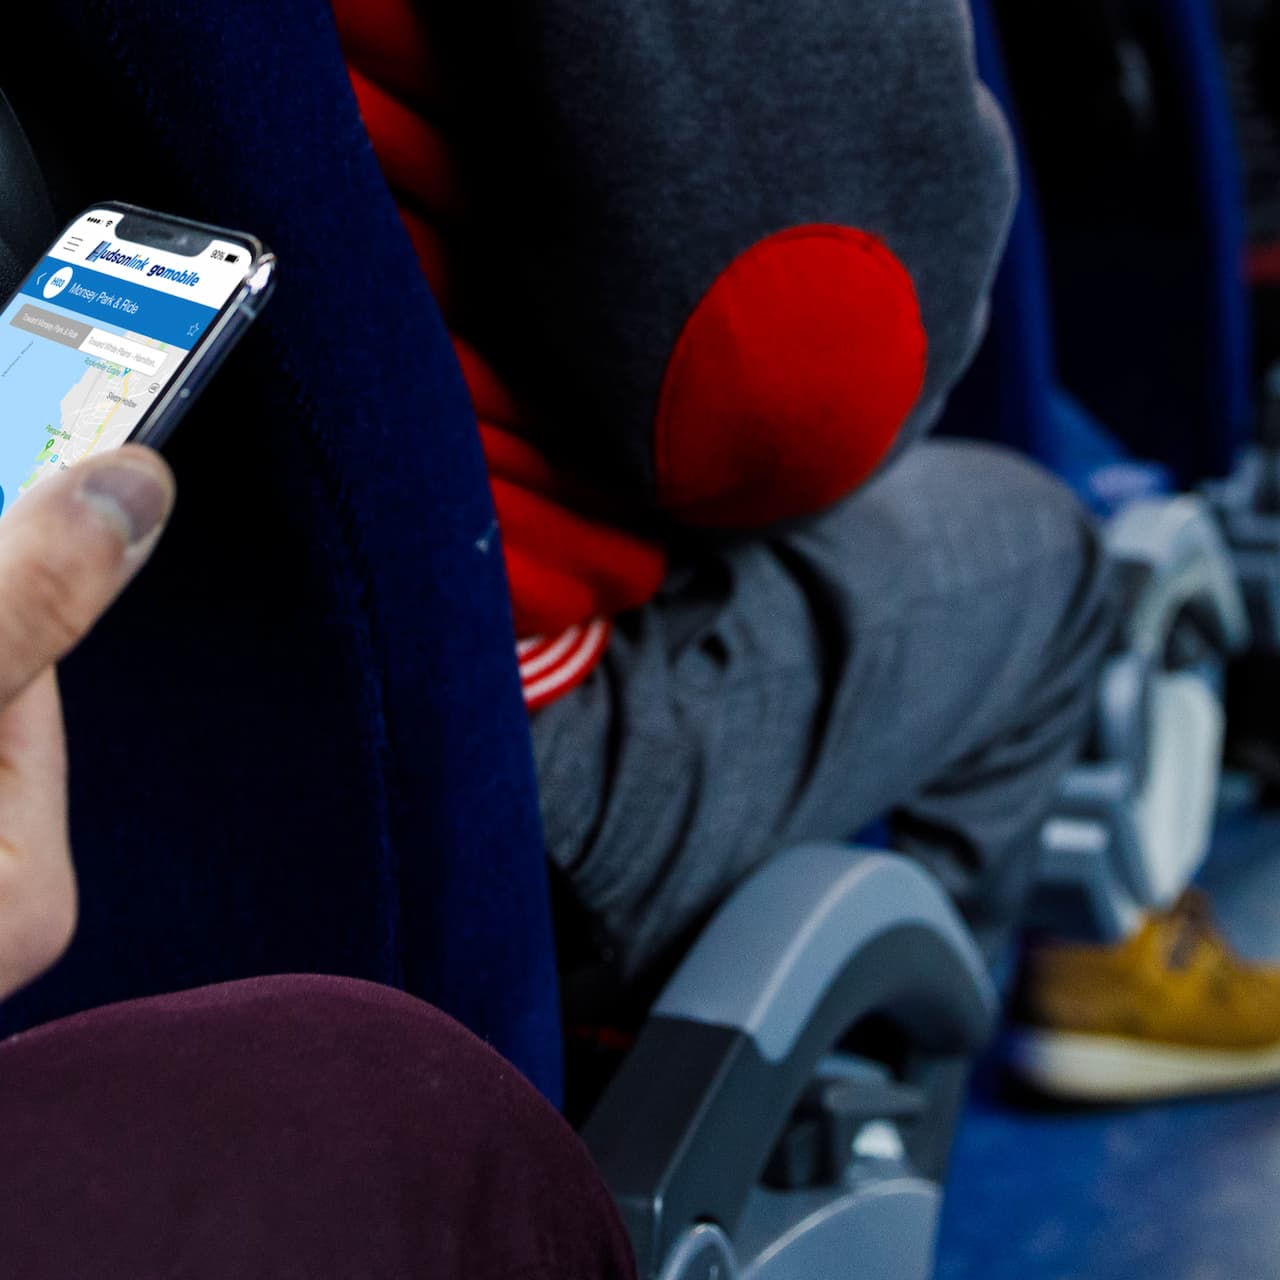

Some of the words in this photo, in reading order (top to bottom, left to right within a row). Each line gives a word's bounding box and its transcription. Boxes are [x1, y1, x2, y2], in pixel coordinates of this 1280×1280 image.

[85, 240, 150, 271] Hudsonlink
[147, 263, 200, 287] gomobile
[68, 282, 97, 303] Monsey
[96, 291, 114, 308] Park
[120, 297, 140, 315] Ride
